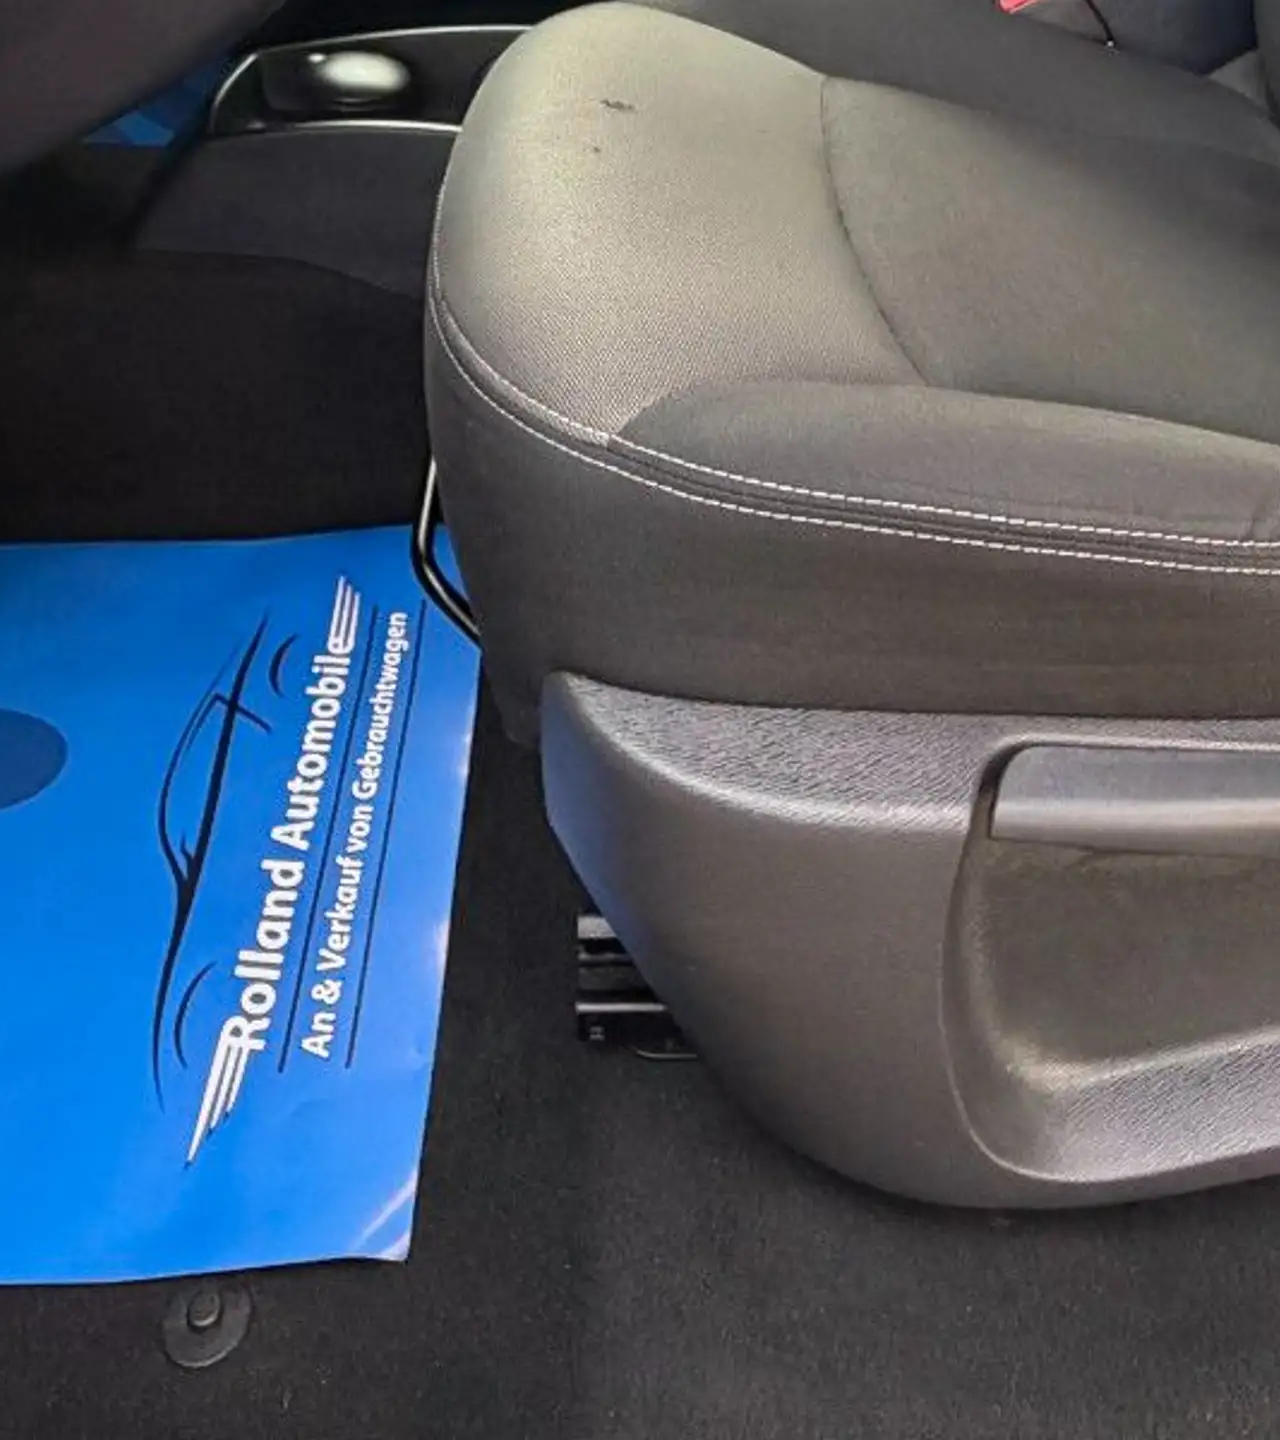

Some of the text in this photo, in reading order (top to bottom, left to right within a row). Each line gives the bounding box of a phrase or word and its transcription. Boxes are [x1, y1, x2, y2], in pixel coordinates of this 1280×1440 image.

[220, 636, 357, 1050] Rolland Automobile
[300, 611, 410, 1059] An & Verkauf von Gebrauchtwagen
